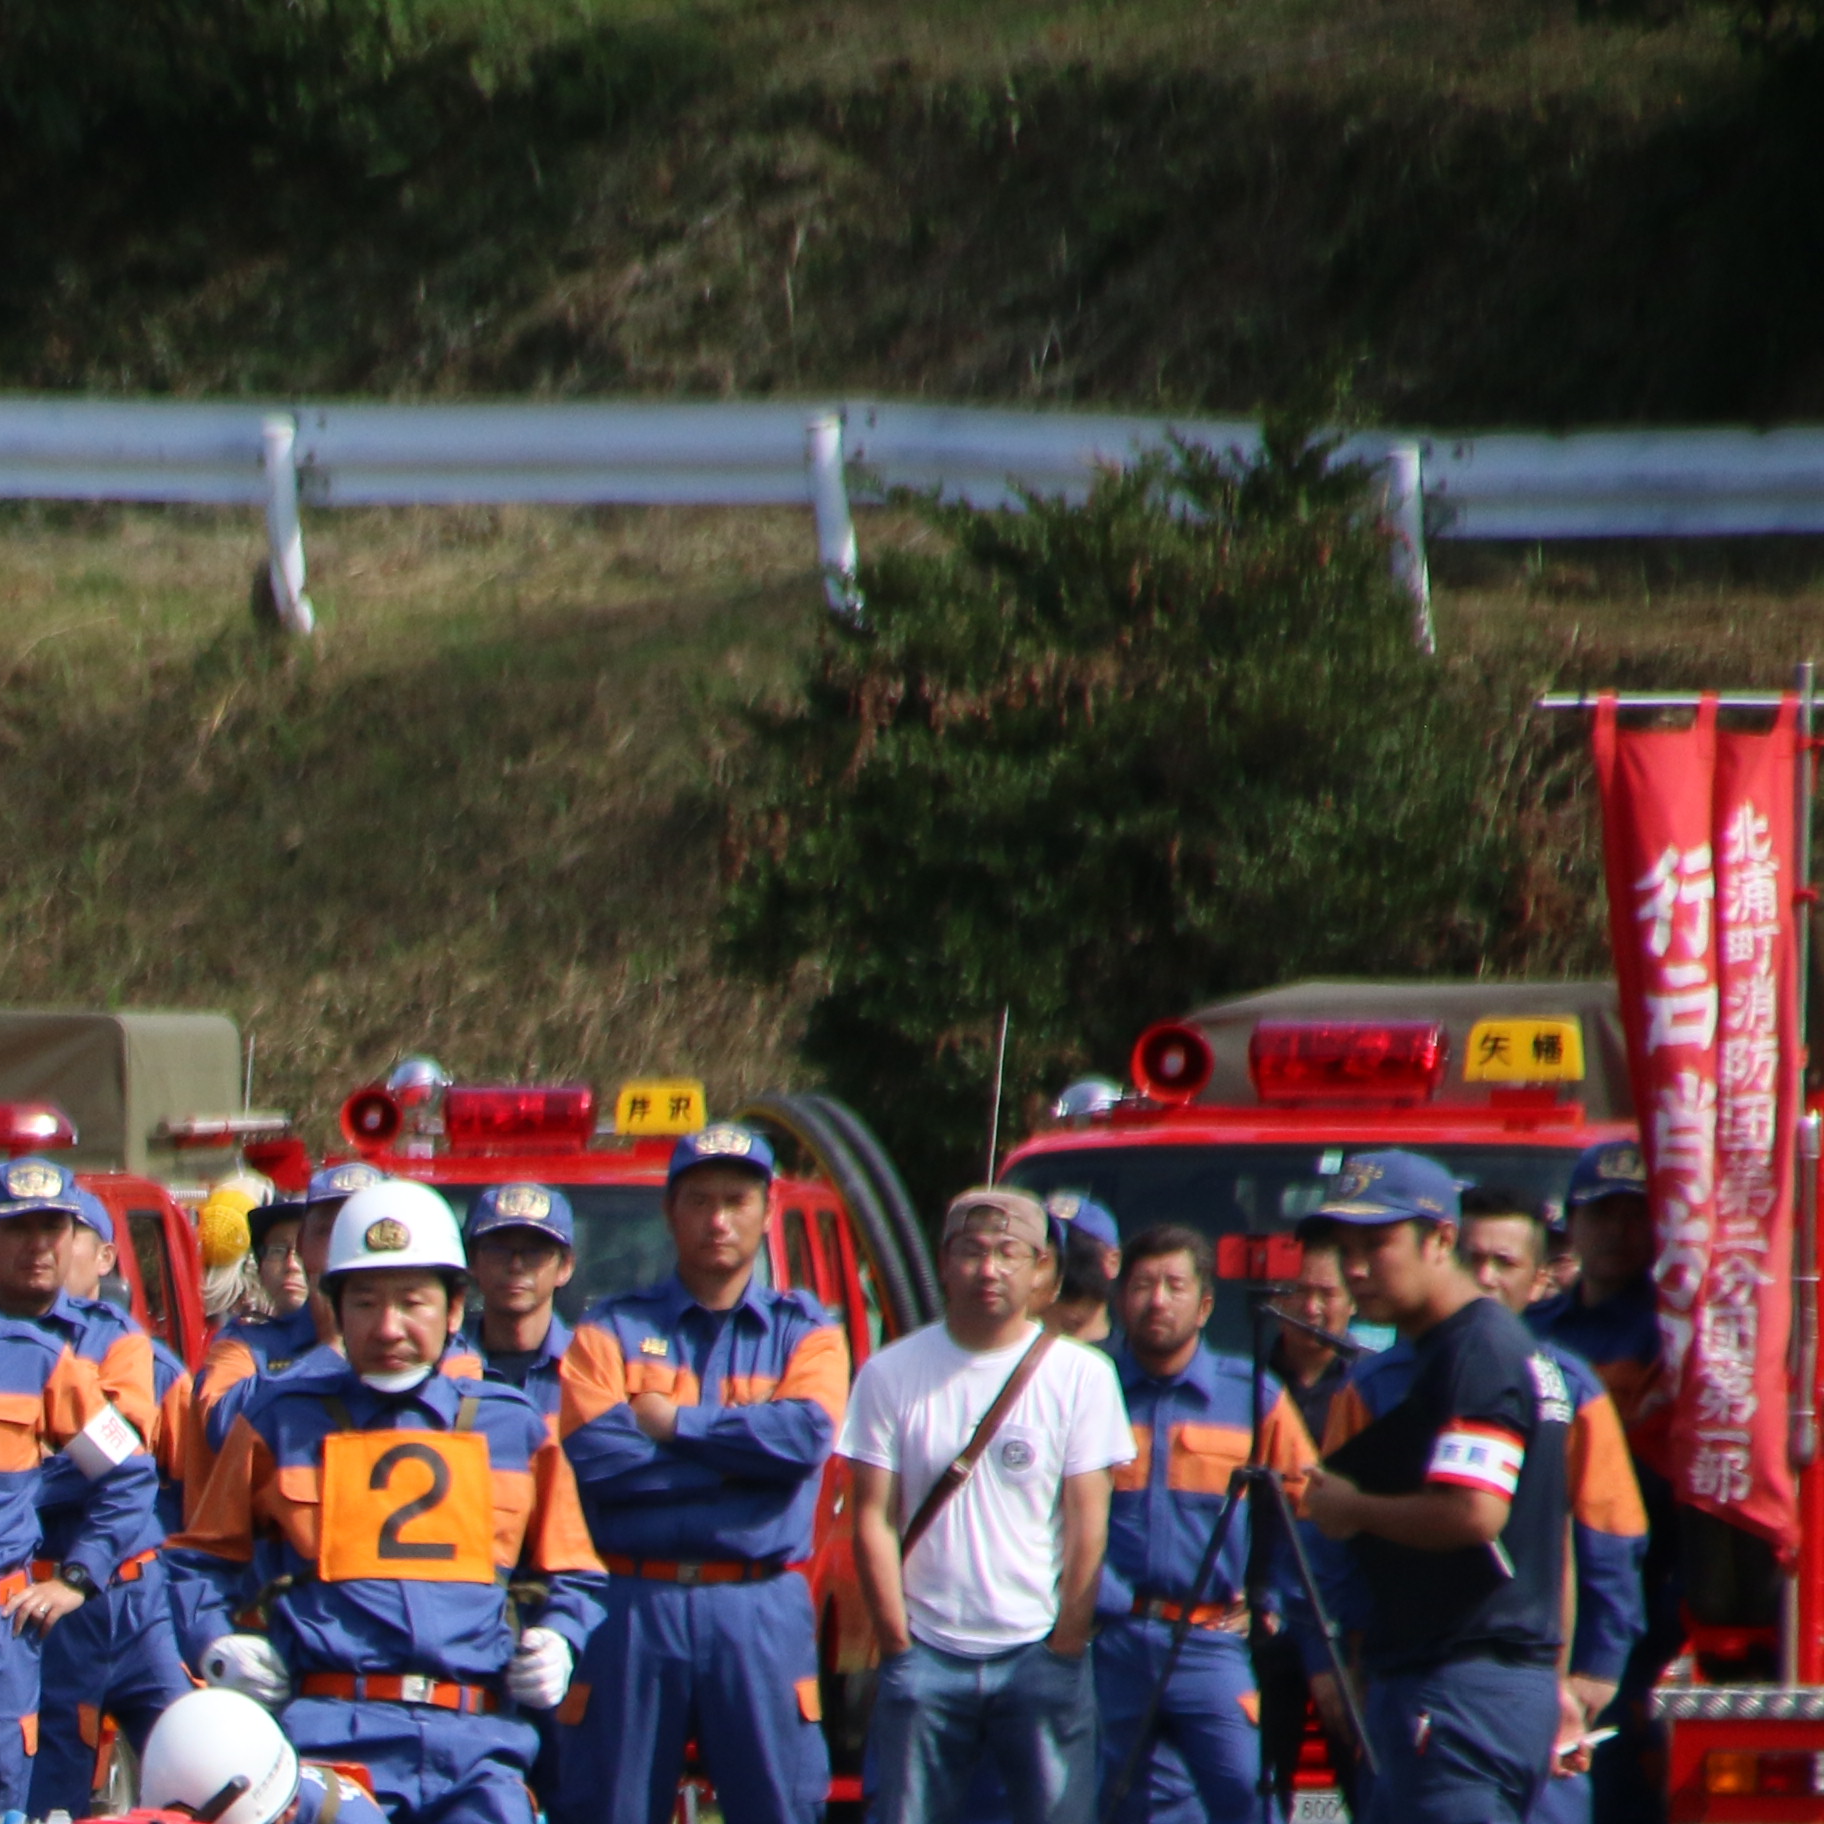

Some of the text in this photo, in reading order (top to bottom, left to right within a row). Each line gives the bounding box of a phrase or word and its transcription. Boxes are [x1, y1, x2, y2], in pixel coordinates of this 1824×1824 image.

[1478, 1032, 1563, 1066] 矢幡
[627, 1096, 692, 1122] 芹沢
[369, 1442, 457, 1560] 2
[1302, 1800, 1339, 1820] 800
